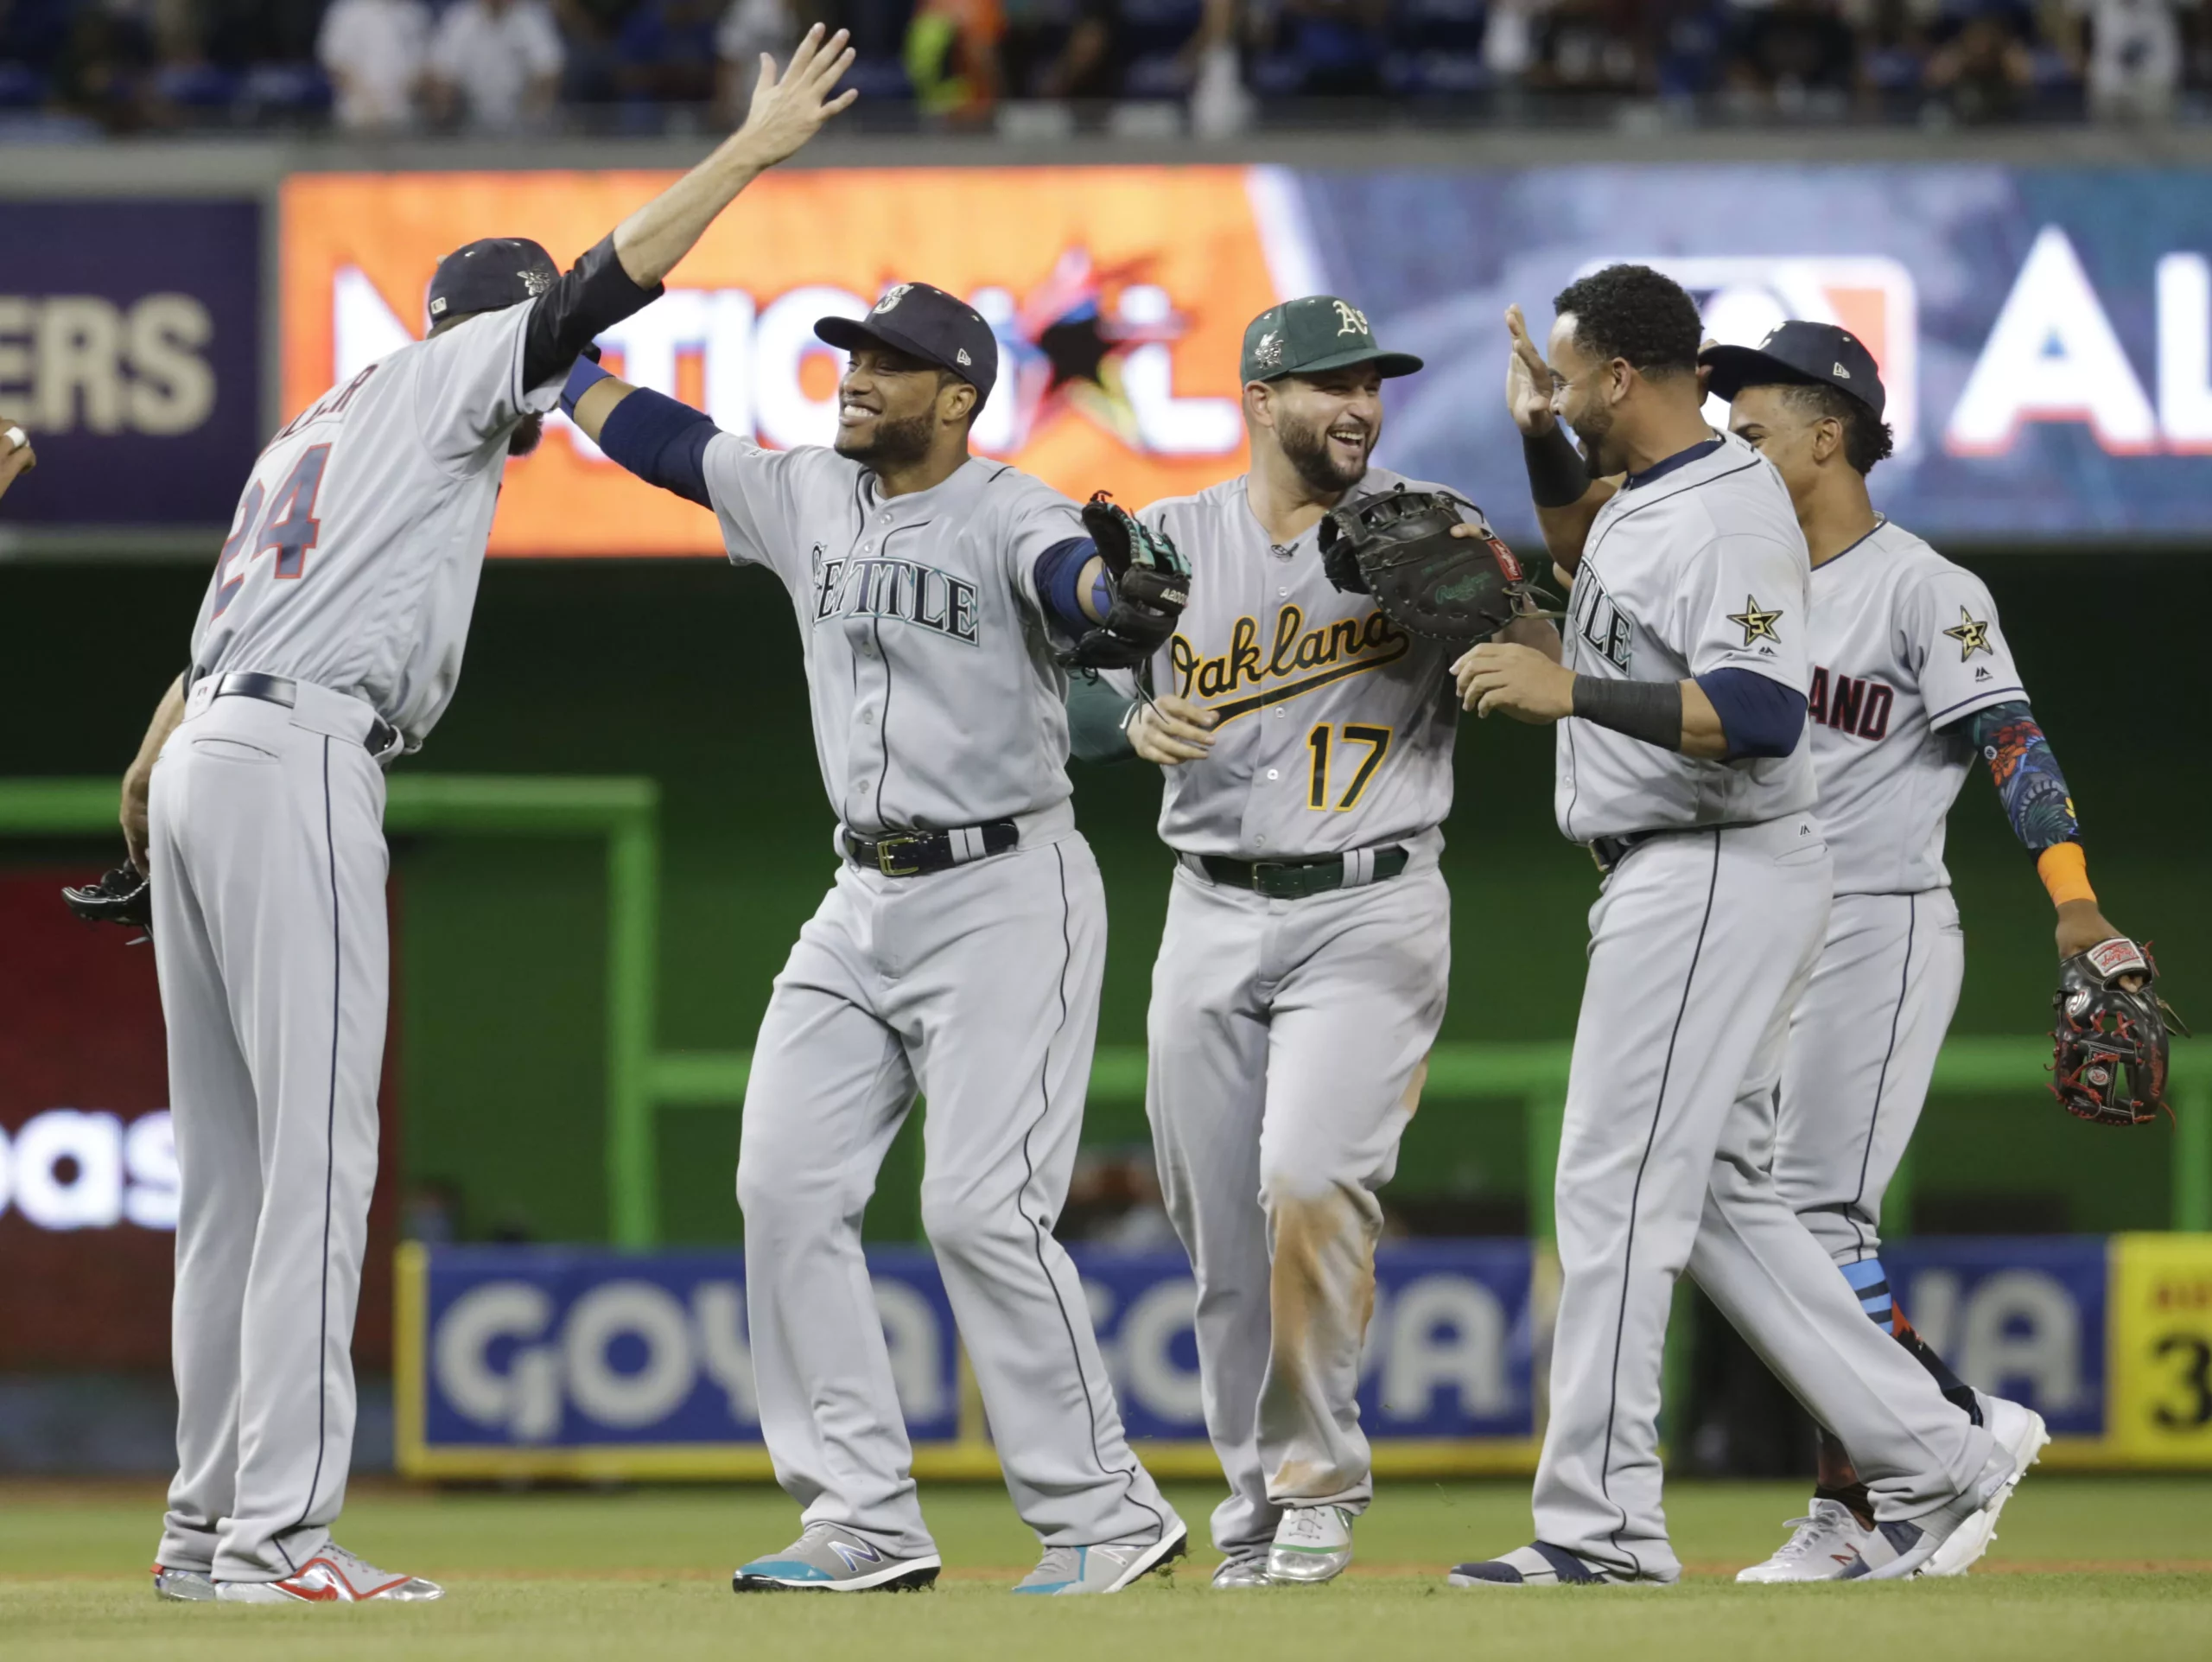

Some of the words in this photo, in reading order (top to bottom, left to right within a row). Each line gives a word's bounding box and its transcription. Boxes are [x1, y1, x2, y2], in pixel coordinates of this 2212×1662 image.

[208, 442, 321, 629] 24
[1747, 613, 1765, 634] 5
[1962, 622, 1981, 647] 2
[1306, 722, 1393, 812] 17
[0, 1107, 179, 1232] as
